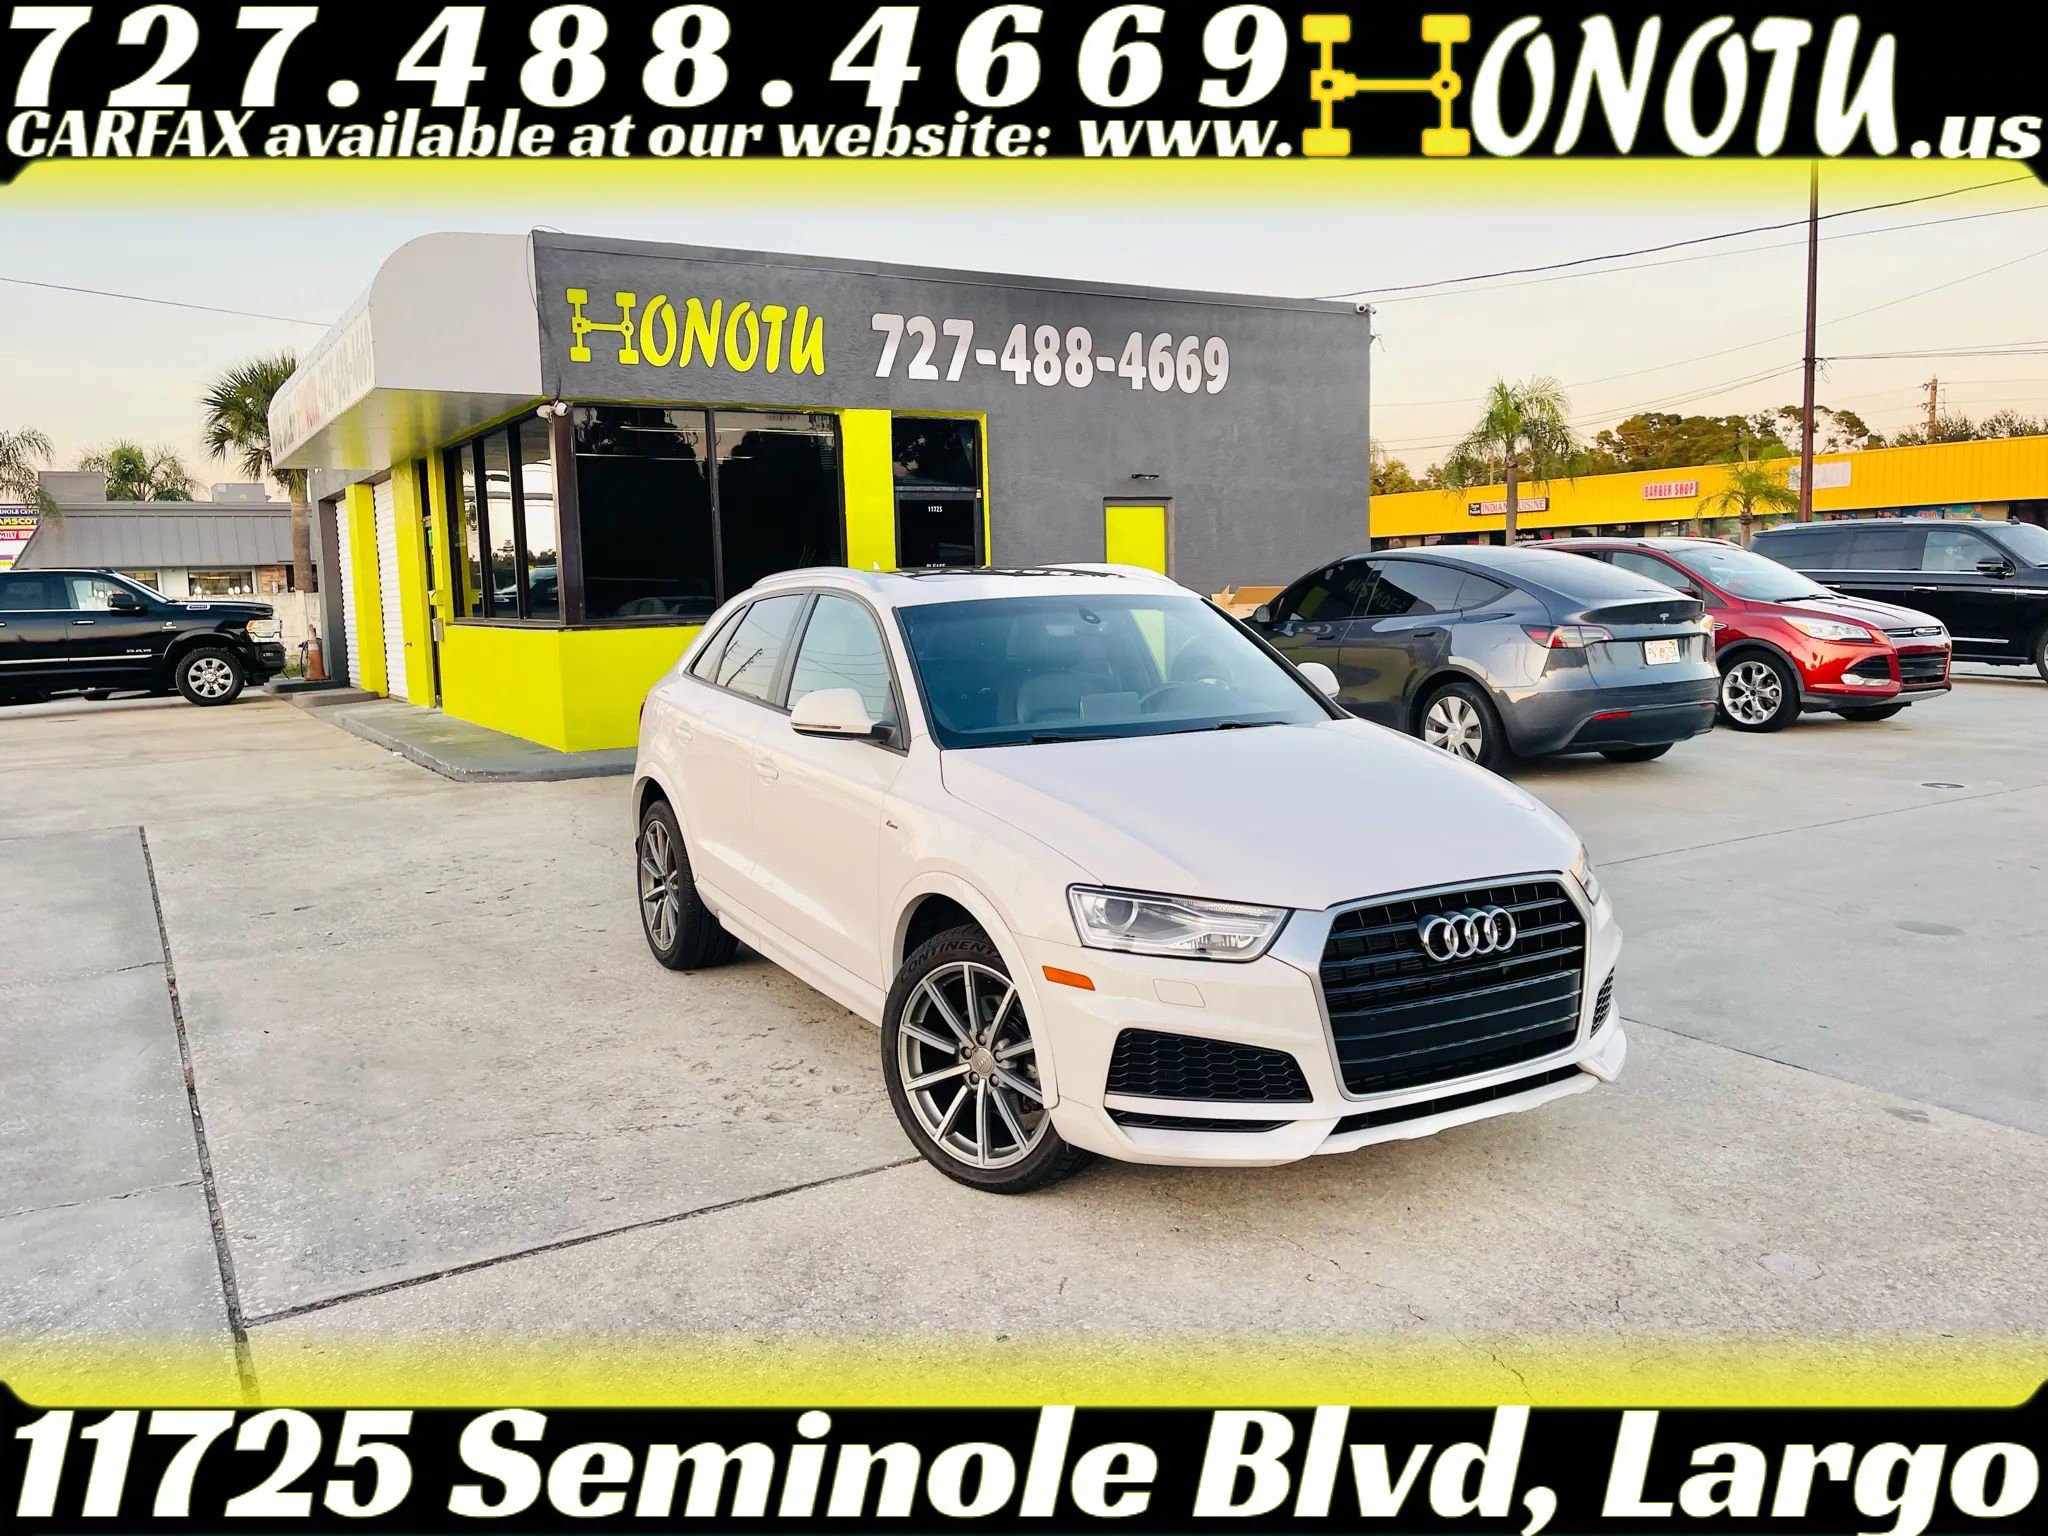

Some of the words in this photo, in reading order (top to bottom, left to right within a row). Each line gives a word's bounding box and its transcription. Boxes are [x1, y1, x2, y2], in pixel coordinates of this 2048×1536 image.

[566, 288, 826, 376] HONOTU
[871, 312, 1230, 395] 727-488-4669
[1644, 485, 1672, 497] BARBER
[1674, 483, 1694, 495] SHOP
[927, 505, 943, 513] 11725
[1518, 500, 1545, 511] UISINE
